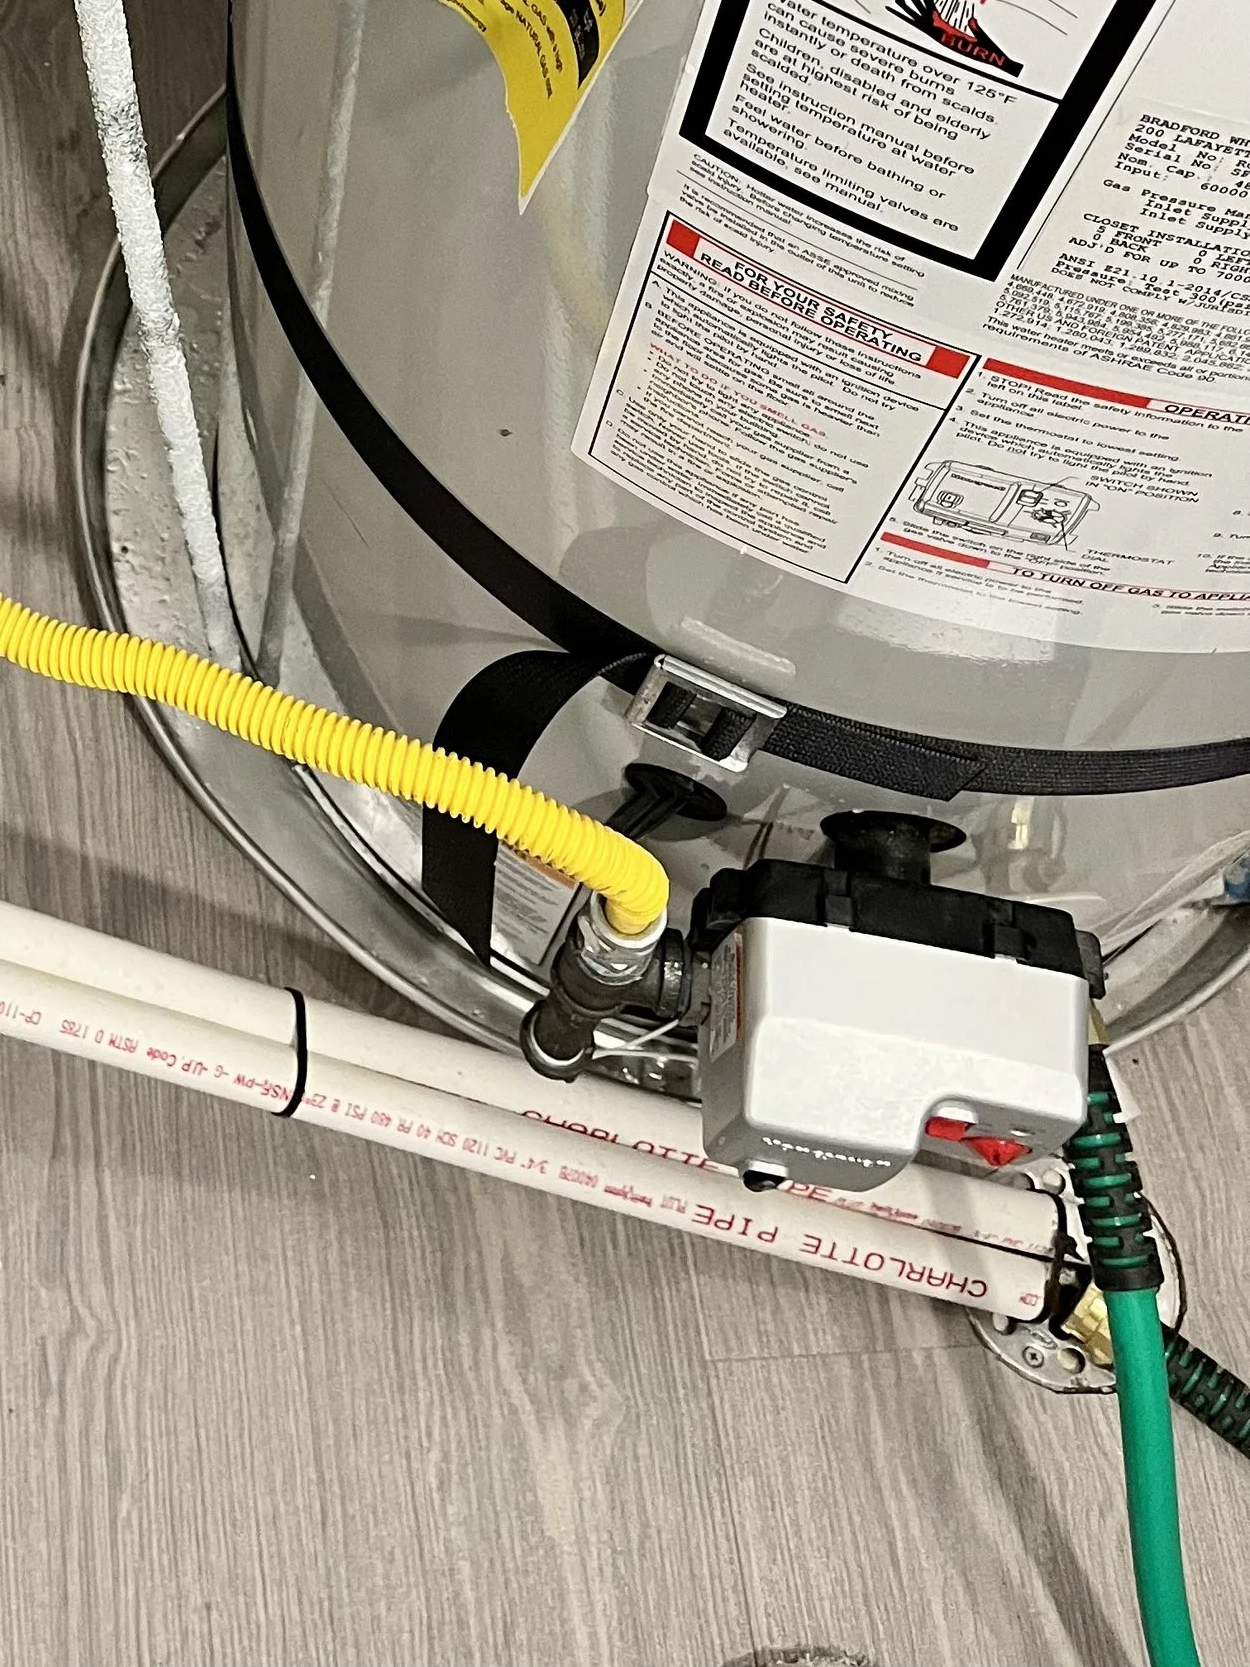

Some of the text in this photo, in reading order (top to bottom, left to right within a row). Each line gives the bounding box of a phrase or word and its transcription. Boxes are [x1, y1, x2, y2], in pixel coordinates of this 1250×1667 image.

[766, 2, 955, 95] can cause severe burns
[821, 15, 918, 67] temperature
[922, 64, 961, 84] over
[967, 80, 1017, 104] 125°F
[938, 28, 1008, 70] BURN
[750, 48, 809, 84] scalded.
[763, 10, 994, 122] instantly or death from scalds.
[739, 79, 788, 111] heater.
[754, 38, 958, 141] are at highest risk of being
[758, 27, 991, 140] Children, disabled and elderly
[731, 104, 804, 149] showering.
[740, 72, 956, 176] setting temperature at water
[745, 62, 974, 174] See instruction manual before
[1134, 123, 1165, 137] 200
[1138, 113, 1220, 140] BRADFORD
[734, 93, 946, 198] Feel water before bathing or
[1123, 141, 1181, 163] Serial
[1127, 132, 1176, 152] Model
[722, 128, 881, 211] available, see manual.
[728, 116, 958, 231] Temperature limiting valves are
[1102, 178, 1216, 212] Gas Pressure
[1199, 182, 1248, 198] 60000
[1082, 212, 1139, 233] CLOSET
[1139, 207, 1186, 225] Inlet
[1144, 198, 1191, 216] Inlet
[1108, 237, 1148, 253] BACK
[1113, 229, 1162, 247] FRONT
[1122, 250, 1151, 263] FOR
[1158, 258, 1179, 268] UP
[1187, 264, 1206, 275] TO
[699, 252, 922, 367] READ BEFORE OPERATING
[733, 260, 893, 339] FOR YOUR SAFETY
[1084, 480, 1099, 488] IN
[1134, 488, 1200, 504] POSITION
[1089, 474, 1198, 497] SWITCH SHOWN
[1080, 548, 1173, 565] THERMOSTAT DIAL
[1011, 567, 1193, 600] TO TURN OFF GAS TO
[107, 1035, 137, 1053] ASTM
[145, 1046, 177, 1067] Code
[461, 1137, 488, 1157] 1120
[493, 1146, 516, 1164] PVC
[691, 1203, 778, 1243] PIPE
[799, 1233, 988, 1298] CHARLOTTE
